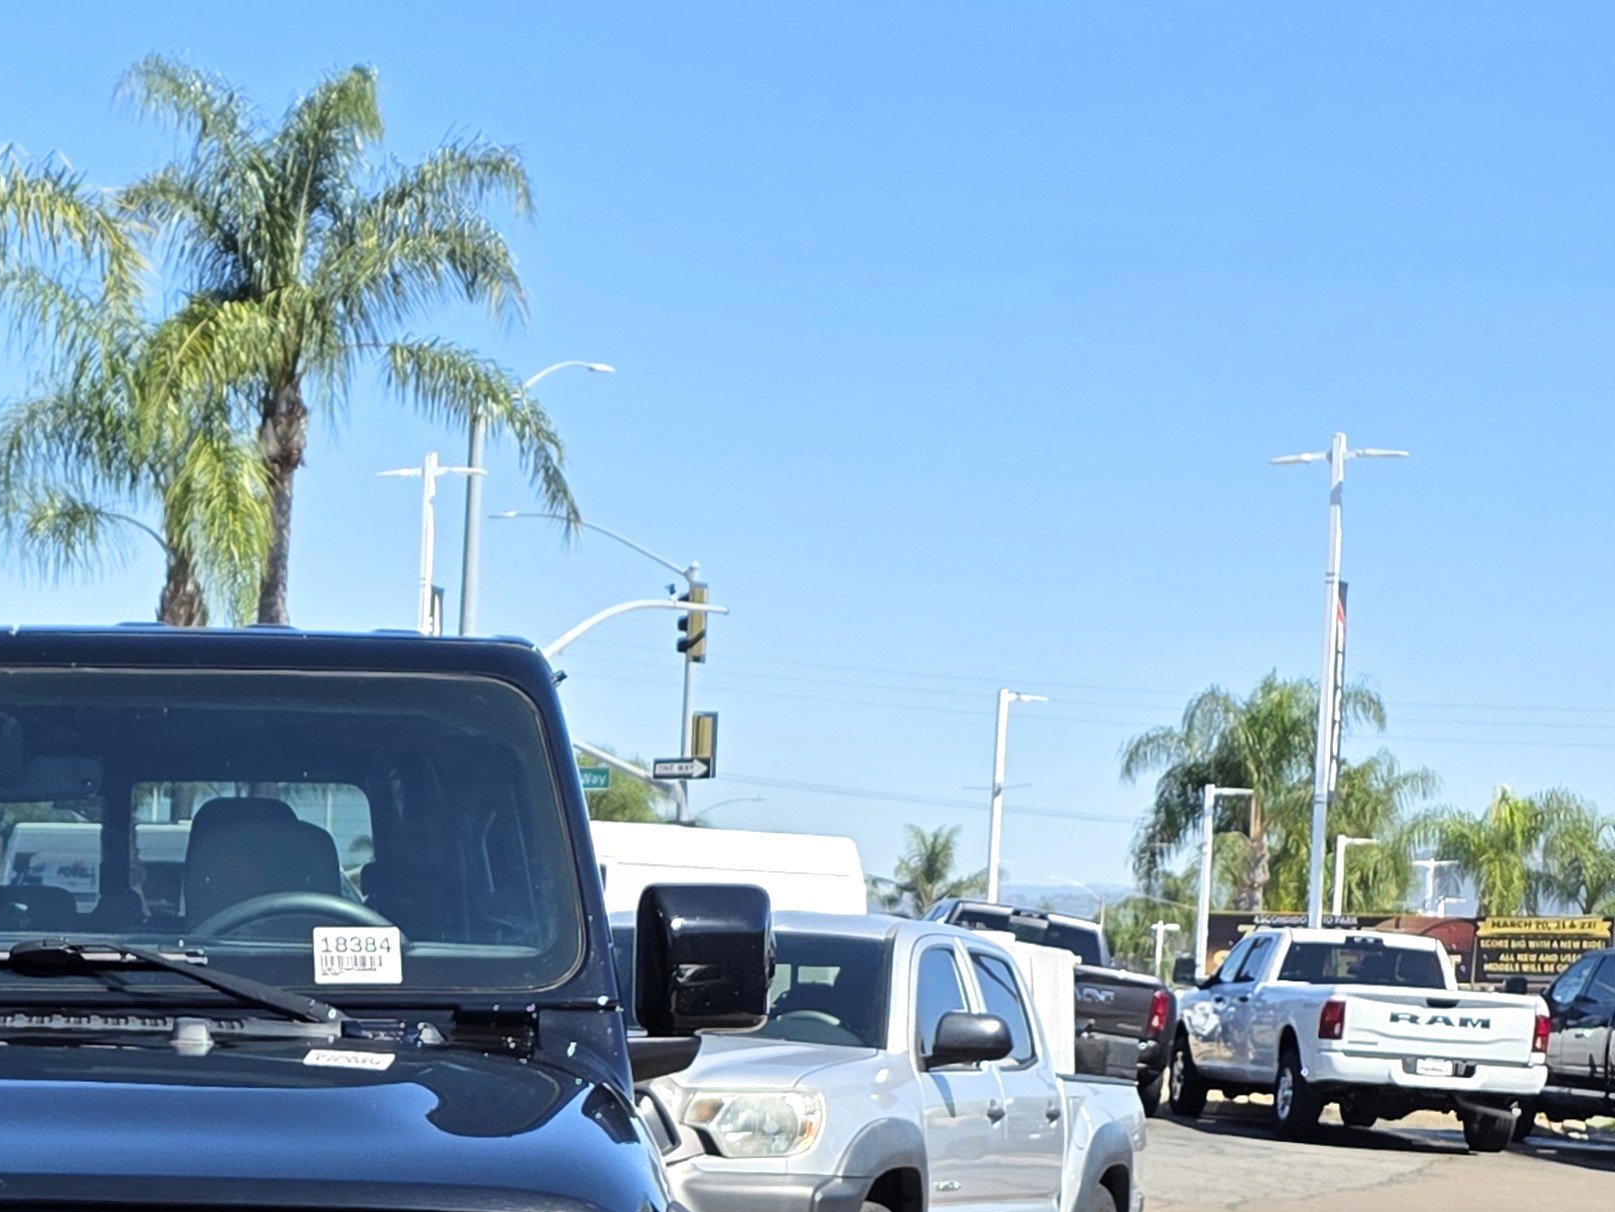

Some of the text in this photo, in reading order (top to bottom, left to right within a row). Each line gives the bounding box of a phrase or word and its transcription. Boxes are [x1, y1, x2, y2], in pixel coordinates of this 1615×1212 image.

[658, 763, 693, 771] ONE WAY
[1491, 920, 1532, 929] MARCH
[320, 936, 391, 953] 18384
[1480, 939, 1509, 948] SCORE
[1552, 939, 1559, 948] A
[1560, 939, 1581, 949] NEW
[1499, 953, 1515, 962] ALL
[1538, 953, 1559, 963] AND
[1390, 1012, 1491, 1029] RAM
